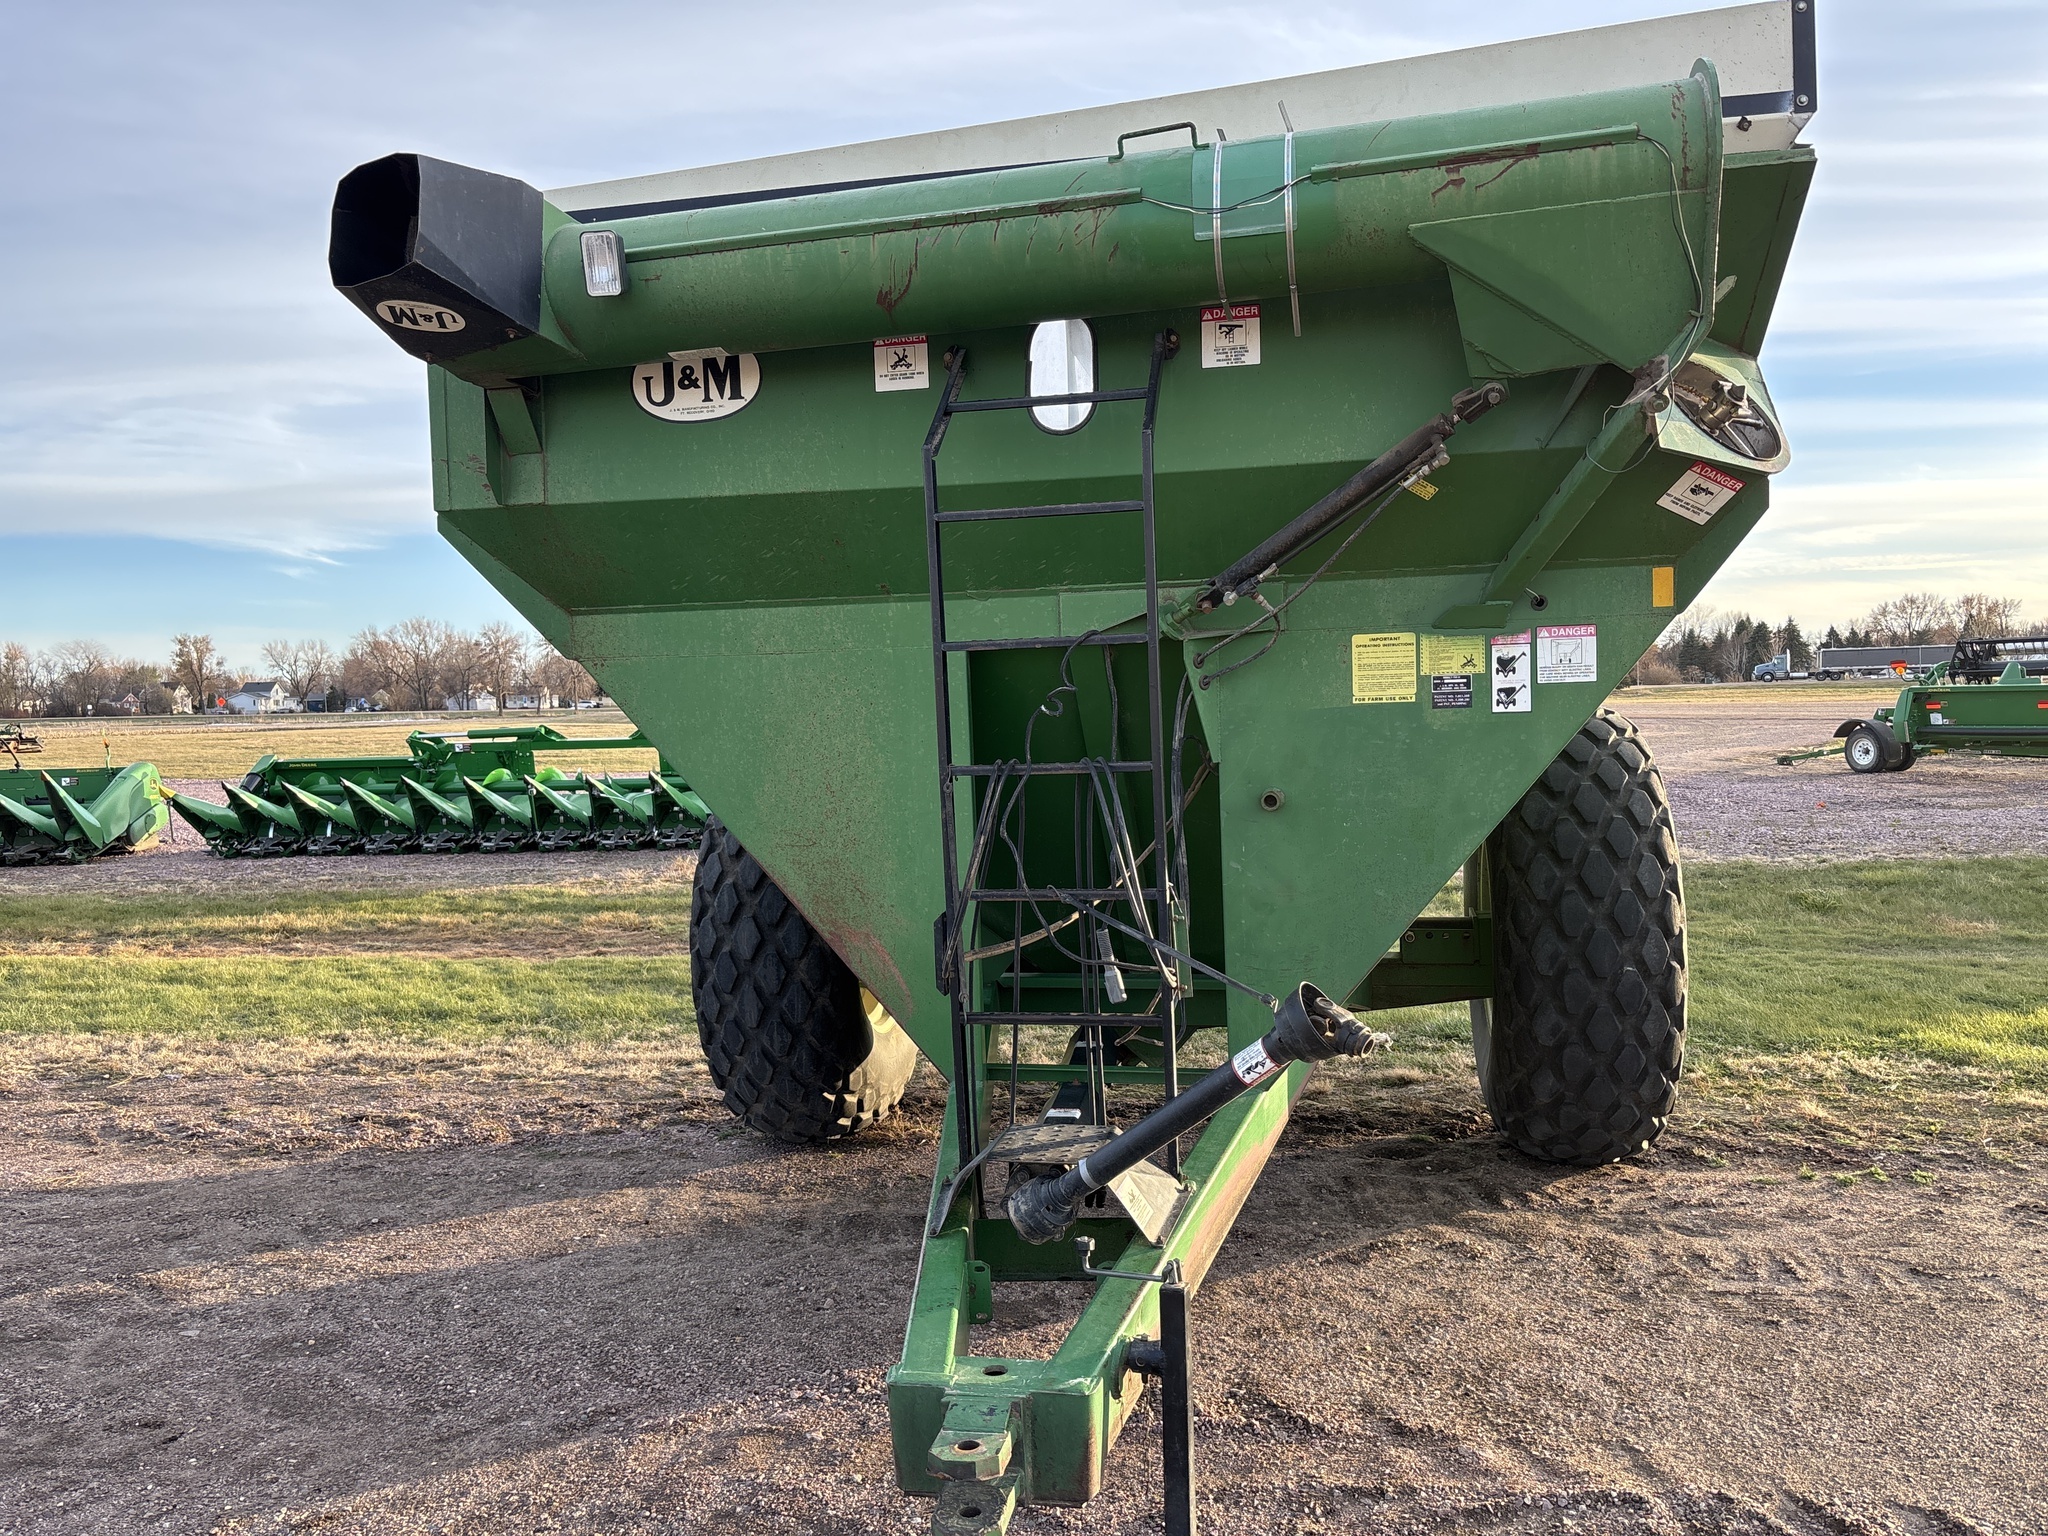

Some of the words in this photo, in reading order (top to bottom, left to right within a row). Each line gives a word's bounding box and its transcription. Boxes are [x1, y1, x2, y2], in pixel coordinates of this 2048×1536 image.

[384, 305, 459, 329] J&M
[642, 355, 745, 407] J&M
[1701, 467, 1743, 491] DANGER
[1551, 627, 1595, 636] DANGER
